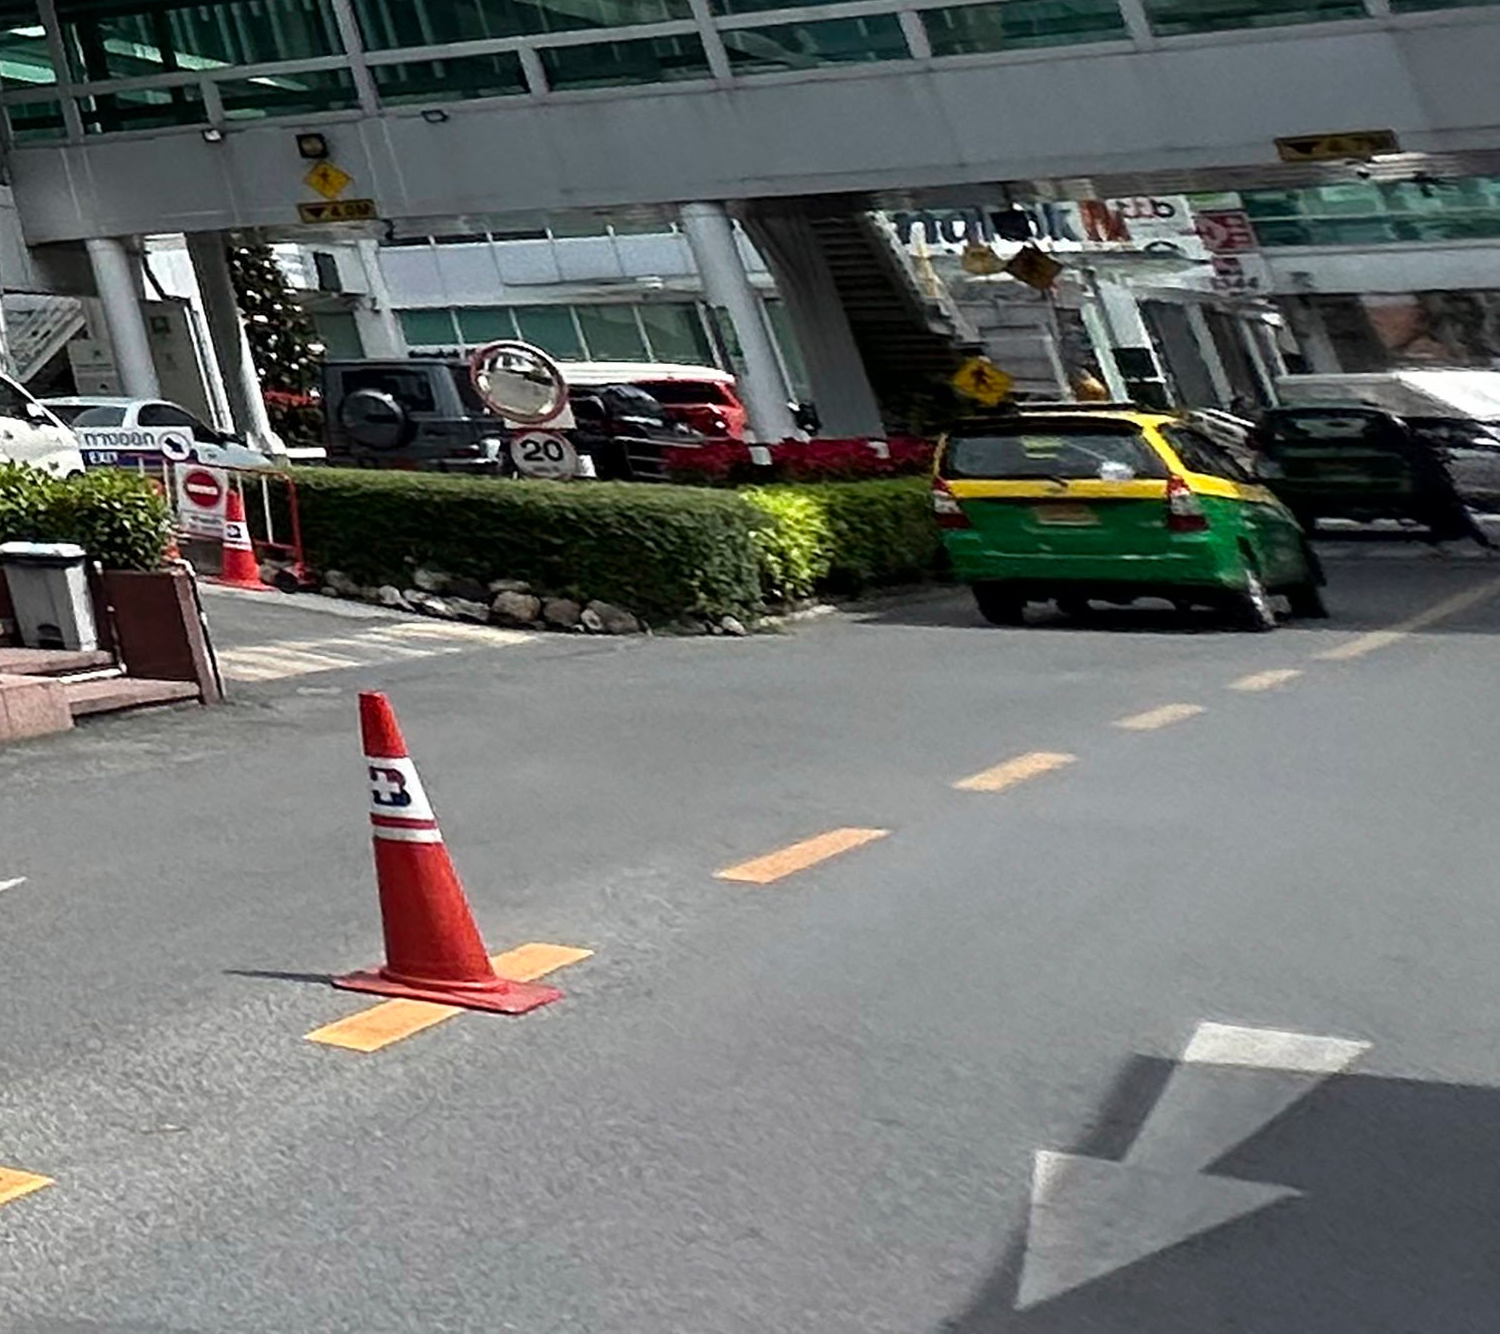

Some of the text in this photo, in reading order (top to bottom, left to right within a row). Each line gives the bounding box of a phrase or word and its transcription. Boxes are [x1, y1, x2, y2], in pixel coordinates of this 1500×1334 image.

[83, 431, 156, 447] ทางออก
[519, 438, 564, 462] 20
